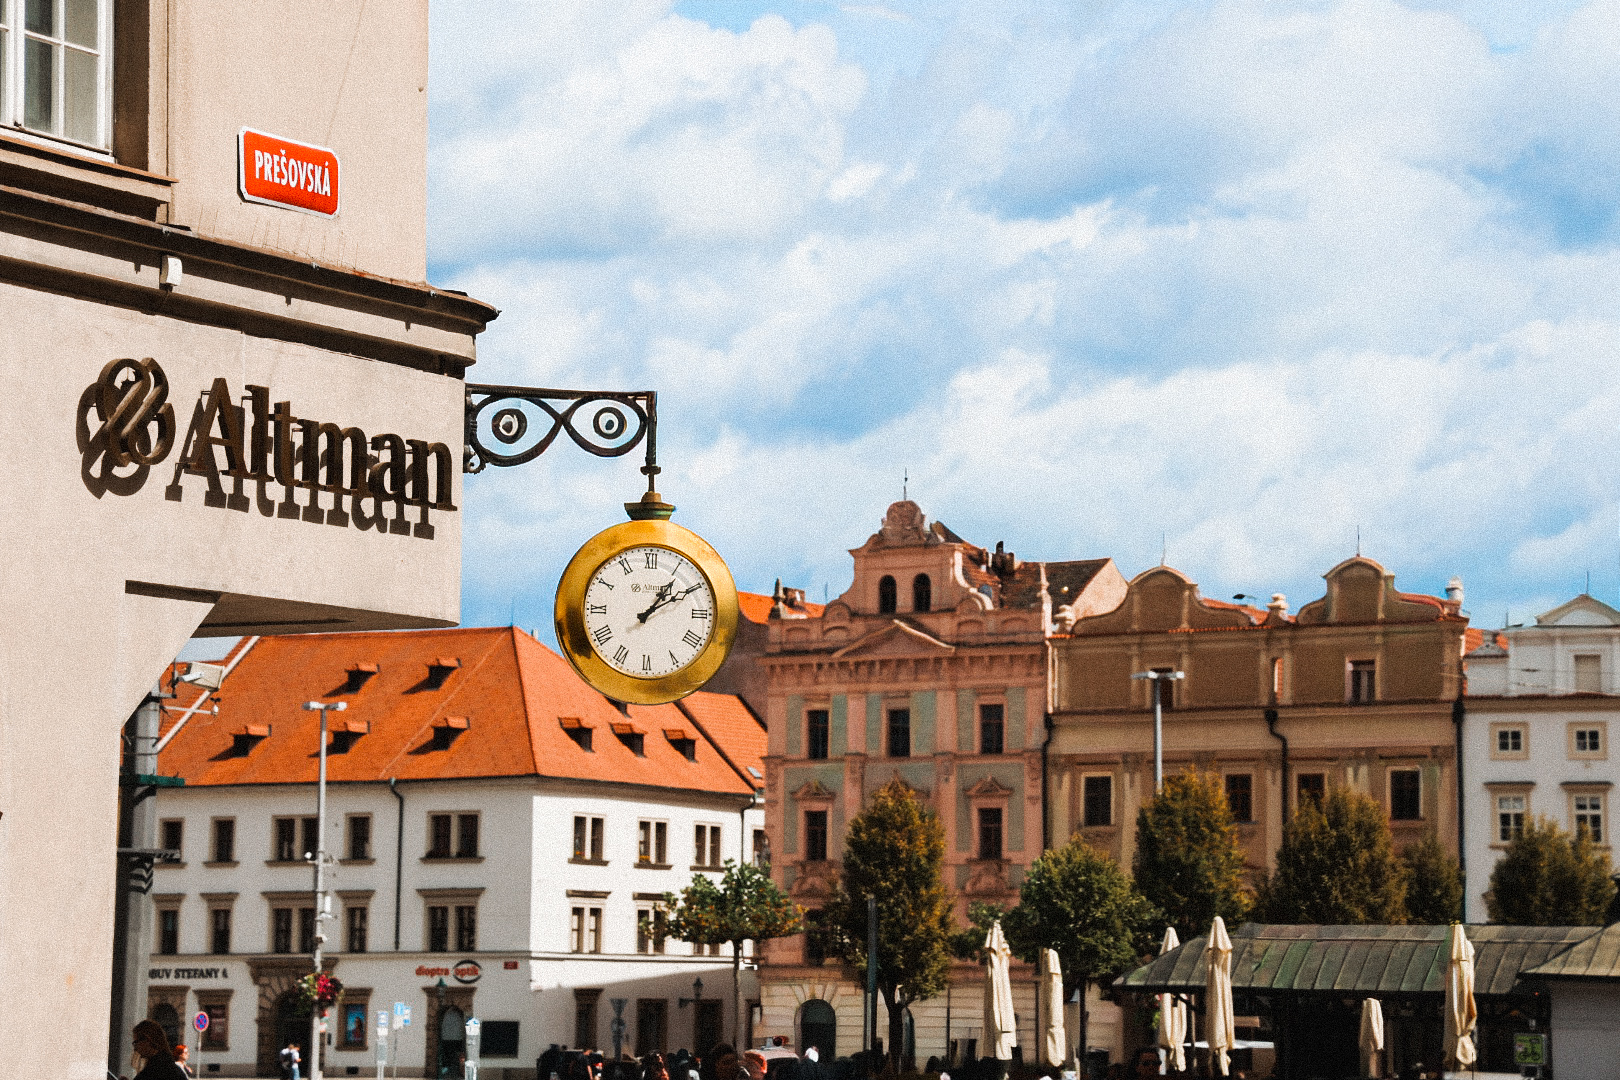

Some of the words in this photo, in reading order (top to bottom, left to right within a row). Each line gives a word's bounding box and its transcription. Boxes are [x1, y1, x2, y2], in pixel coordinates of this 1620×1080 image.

[254, 148, 331, 197] PREŠOVSKÁ
[179, 378, 458, 512] Altman
[643, 583, 670, 592] Altm
